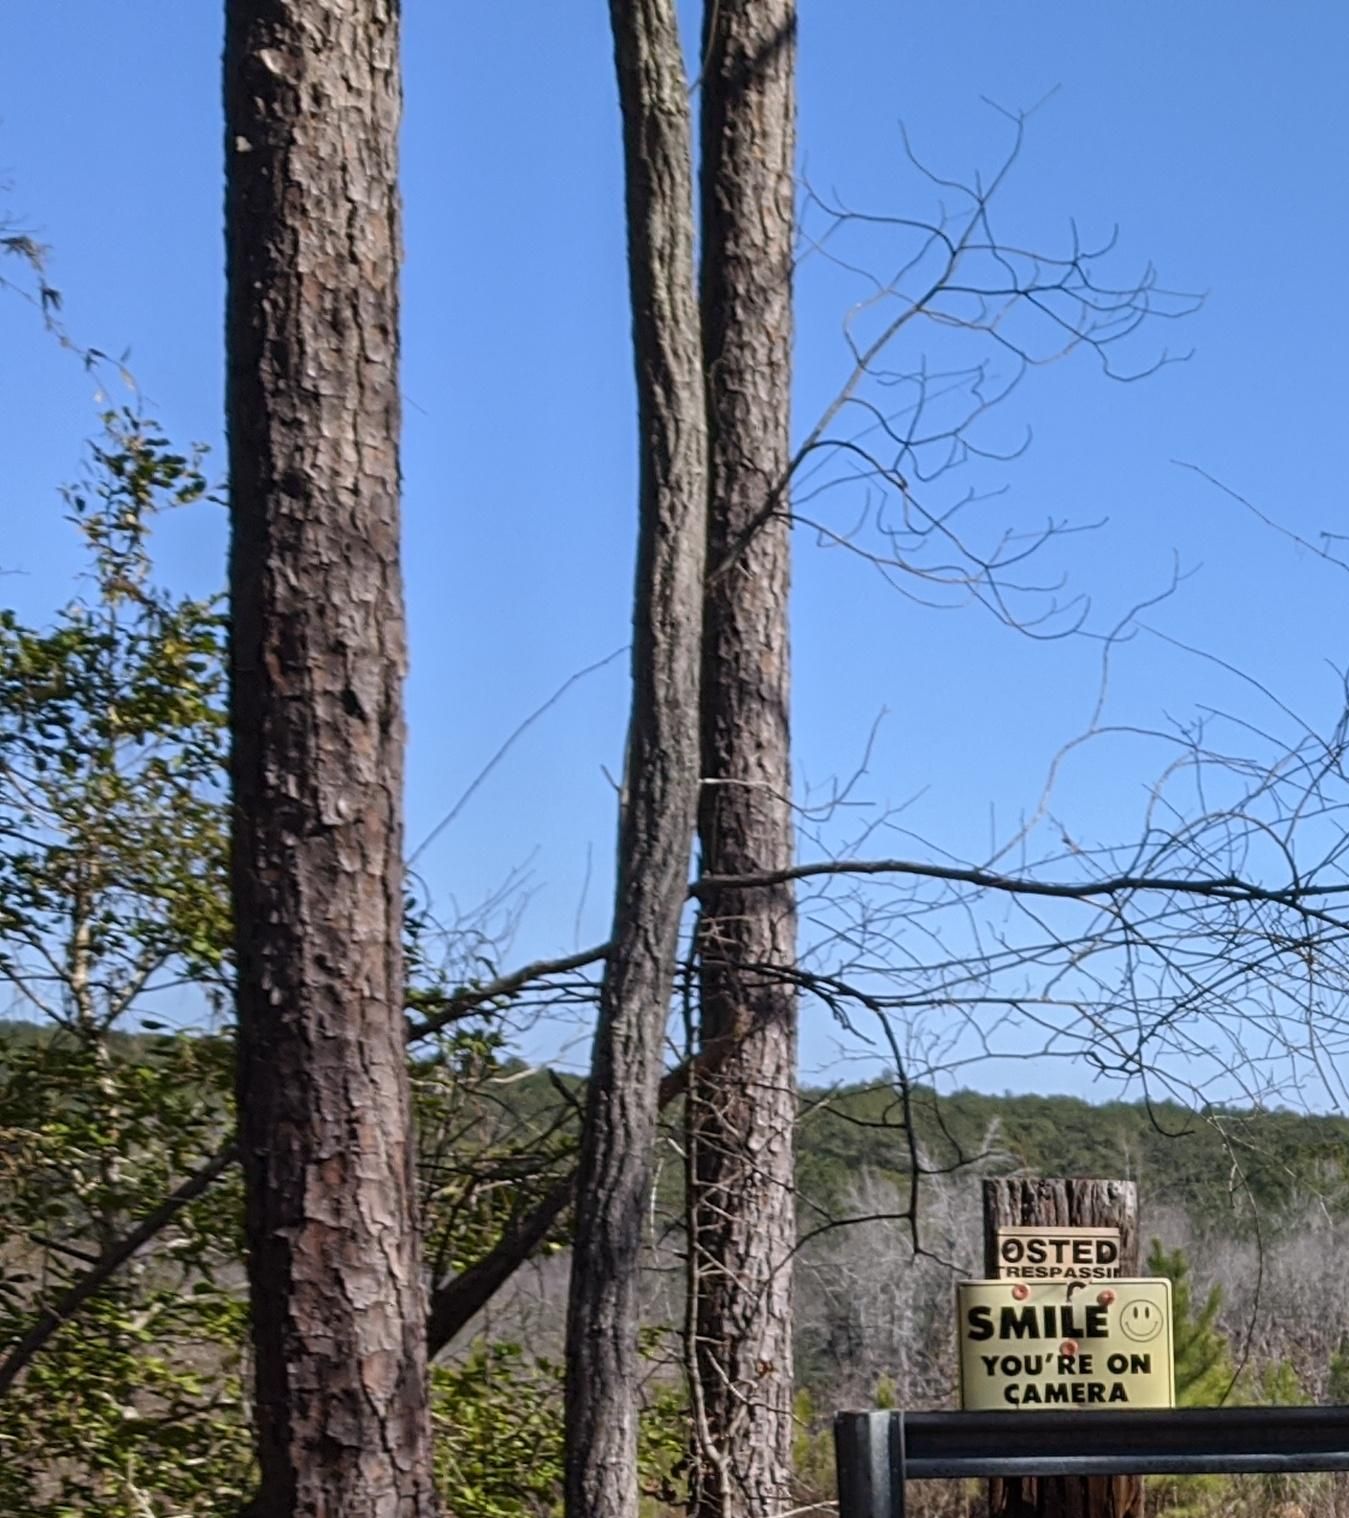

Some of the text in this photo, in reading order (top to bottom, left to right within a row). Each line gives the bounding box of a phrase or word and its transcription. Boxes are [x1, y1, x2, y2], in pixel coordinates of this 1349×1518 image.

[1001, 1238, 1118, 1264] OSTED
[967, 1305, 1109, 1342] SMILE
[981, 1353, 1151, 1376] YOU'RE ON
[1004, 1382, 1129, 1404] CAMERA
